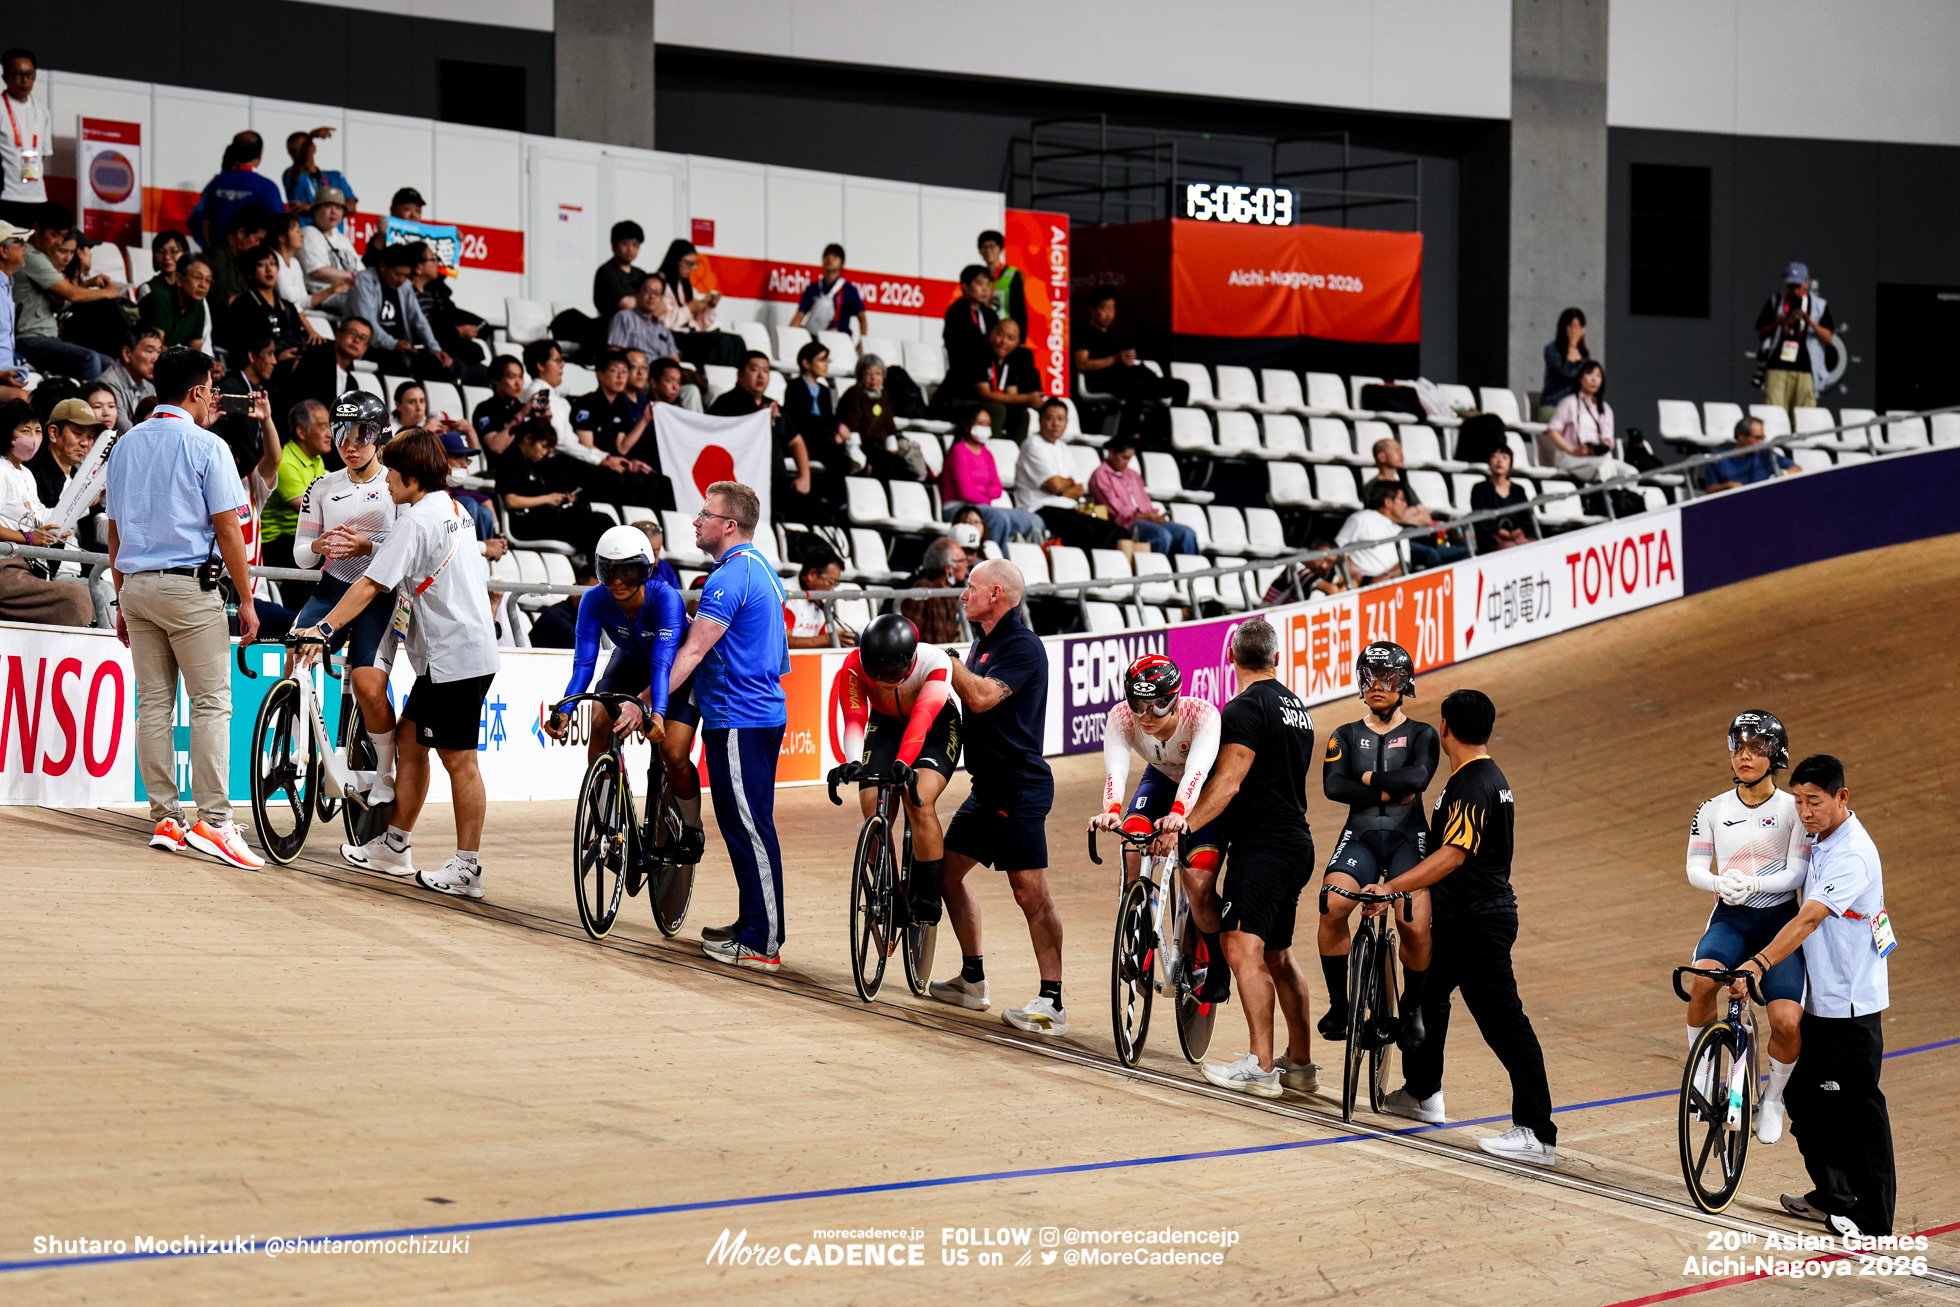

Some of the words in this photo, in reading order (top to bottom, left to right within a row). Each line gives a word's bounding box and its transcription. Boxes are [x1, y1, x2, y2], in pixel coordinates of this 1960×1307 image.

[1187, 183, 1293, 226] 15:06:03
[879, 281, 924, 308] 2026
[1228, 269, 1325, 290] Aichi-Nagoya
[1327, 274, 1364, 292] 2026
[1047, 225, 1068, 395] Aichi-Nagoya
[444, 519, 459, 534] Tea
[1566, 528, 1676, 609] TOYOTA
[1413, 573, 1452, 669] 361°
[1487, 571, 1551, 634] 中部電力
[1285, 602, 1352, 698] JR東海
[847, 674, 860, 709] CHINA
[0, 655, 125, 778] NSO
[1072, 706, 1106, 746] SPORTS
[1280, 706, 1314, 731] JAPAN
[1186, 770, 1202, 800] JAPAN
